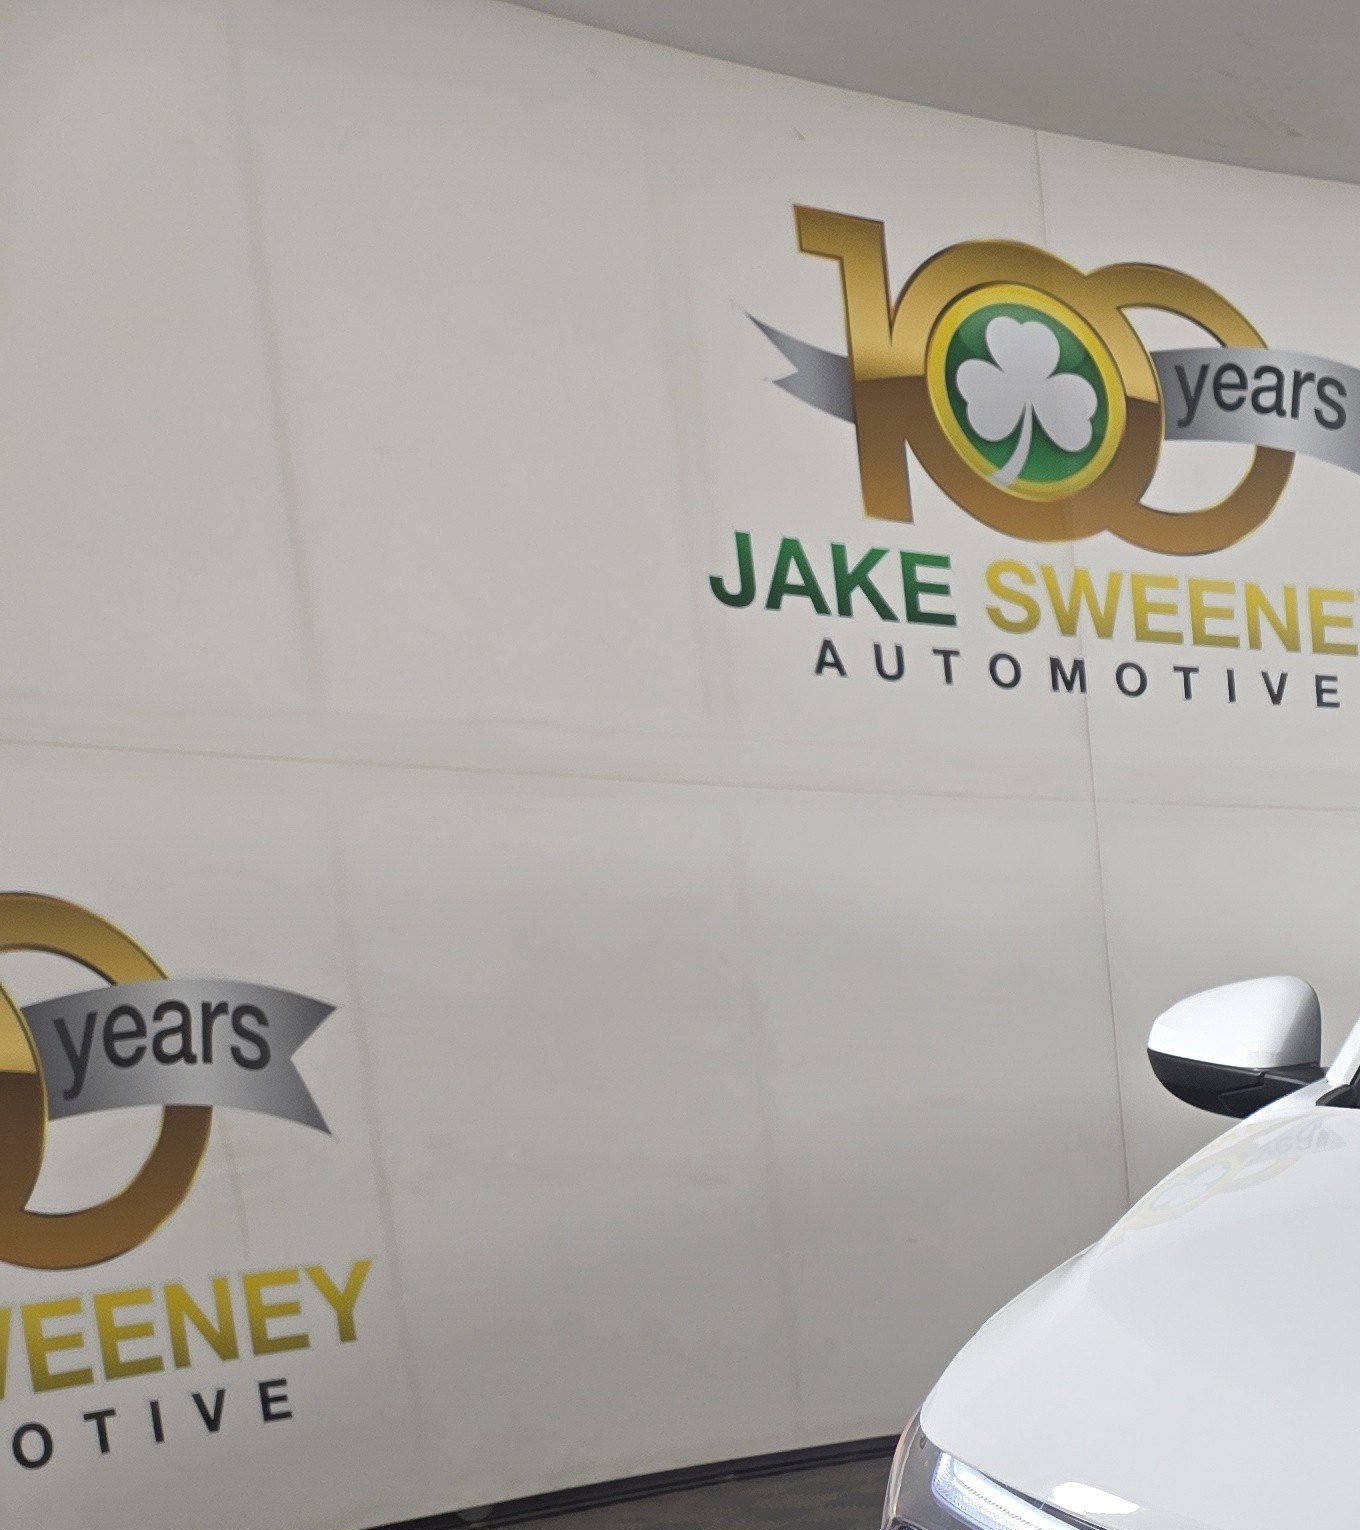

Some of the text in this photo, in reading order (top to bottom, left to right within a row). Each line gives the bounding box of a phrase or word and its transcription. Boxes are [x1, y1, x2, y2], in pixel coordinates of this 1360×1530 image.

[793, 203, 1348, 557] 100 years
[708, 530, 958, 628] JAKE
[814, 639, 1341, 709] AUTOMOTIVE
[53, 999, 272, 1101] years
[0, 1258, 373, 1400] EENEY
[12, 1378, 293, 1470] OTIVE
